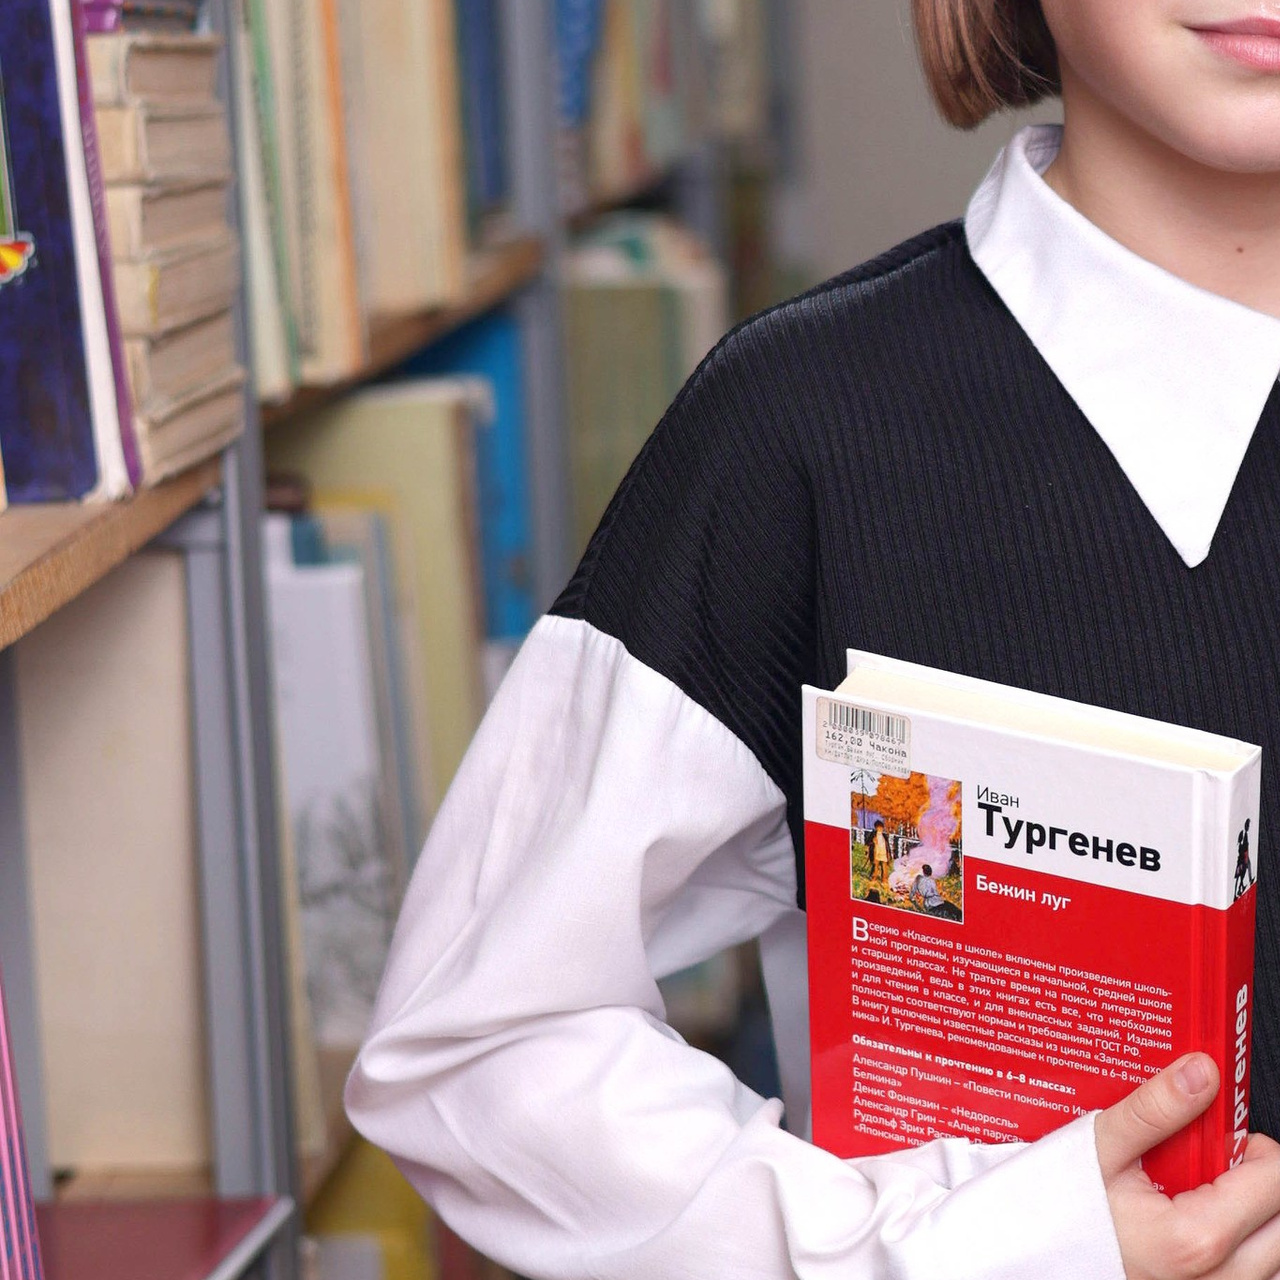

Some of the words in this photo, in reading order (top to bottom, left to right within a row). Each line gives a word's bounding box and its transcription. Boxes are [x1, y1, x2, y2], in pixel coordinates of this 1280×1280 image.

[825, 730, 863, 747] 162,00
[869, 741, 907, 758] Чакона
[976, 784, 1020, 808] Иван
[977, 802, 1161, 872] Тургенев
[976, 874, 1036, 903] Бежин
[1040, 891, 1072, 911] луг
[852, 916, 870, 942] В
[869, 922, 900, 937] серию
[902, 929, 954, 949] «Классика
[964, 944, 1003, 960] школе»
[1005, 953, 1056, 972] включены
[1058, 965, 1132, 989] произведения
[1134, 982, 1172, 997] школь-
[861, 947, 903, 964] старших
[906, 957, 948, 974] классах.
[969, 971, 1007, 987] тратьте
[1010, 981, 1041, 995] время
[1061, 992, 1097, 1008] поиски
[1101, 1002, 1172, 1025] литературных
[869, 936, 888, 947] ной
[890, 940, 949, 962] программы,
[952, 955, 1021, 977] изучающиеся
[1033, 973, 1090, 994] начальной,
[1092, 987, 1135, 1003] средней
[1138, 997, 1173, 1011] школе
[851, 957, 925, 983] произведений,
[929, 976, 954, 989] ведь
[969, 985, 991, 997] этих
[996, 991, 1030, 1006] книгах
[1035, 1000, 1057, 1012] есть
[1061, 1006, 1081, 1019] все,
[1086, 1012, 1104, 1023] что
[1109, 1017, 1172, 1038] необходимо
[852, 983, 904, 1003] полностью
[905, 996, 976, 1020] соответствуют
[978, 1013, 1016, 1029] нормам
[1027, 1024, 1093, 1047] требованиям
[1095, 1038, 1121, 1053] ГОСТ
[1123, 1044, 1141, 1058] РФ.
[862, 973, 881, 984] для
[885, 979, 919, 993] чтения
[933, 990, 969, 1006] классе,
[984, 1002, 1004, 1013] для
[1008, 1007, 1073, 1029] внеклассных
[1077, 1023, 1122, 1040] заданий.
[1127, 1032, 1172, 1051] Издания
[852, 1010, 880, 1023] ника»
[894, 1017, 946, 1040] Тургенева,
[947, 1032, 1037, 1060] рекомендованные
[1046, 1055, 1100, 1075] прочтению
[852, 1033, 923, 1060] Обязательны
[934, 1055, 994, 1076] прочтению
[1028, 1077, 1076, 1096] классах:
[861, 999, 890, 1014] книгу
[891, 1006, 941, 1025] включены
[943, 1018, 995, 1038] известные
[997, 1031, 1044, 1049] рассказы
[1060, 1045, 1091, 1060] цикла
[1093, 1052, 1141, 1071] «Записки
[852, 1066, 903, 1088] Белкина»
[852, 1053, 909, 1077] Александр
[910, 1066, 952, 1086] Пушкин
[962, 1080, 1012, 1100] «Повести
[1013, 1093, 1070, 1113] покойного
[852, 1080, 886, 1098] Денис
[887, 1089, 940, 1111] Фонвизин
[950, 1105, 1019, 1129] «Недоросль»
[853, 1095, 909, 1119] Александр
[910, 1108, 937, 1124] Грин
[947, 1119, 981, 1135] «Алые
[853, 1108, 899, 1131] Рудольф
[900, 1120, 925, 1136] Эрих
[853, 1123, 906, 1143] «Японская
